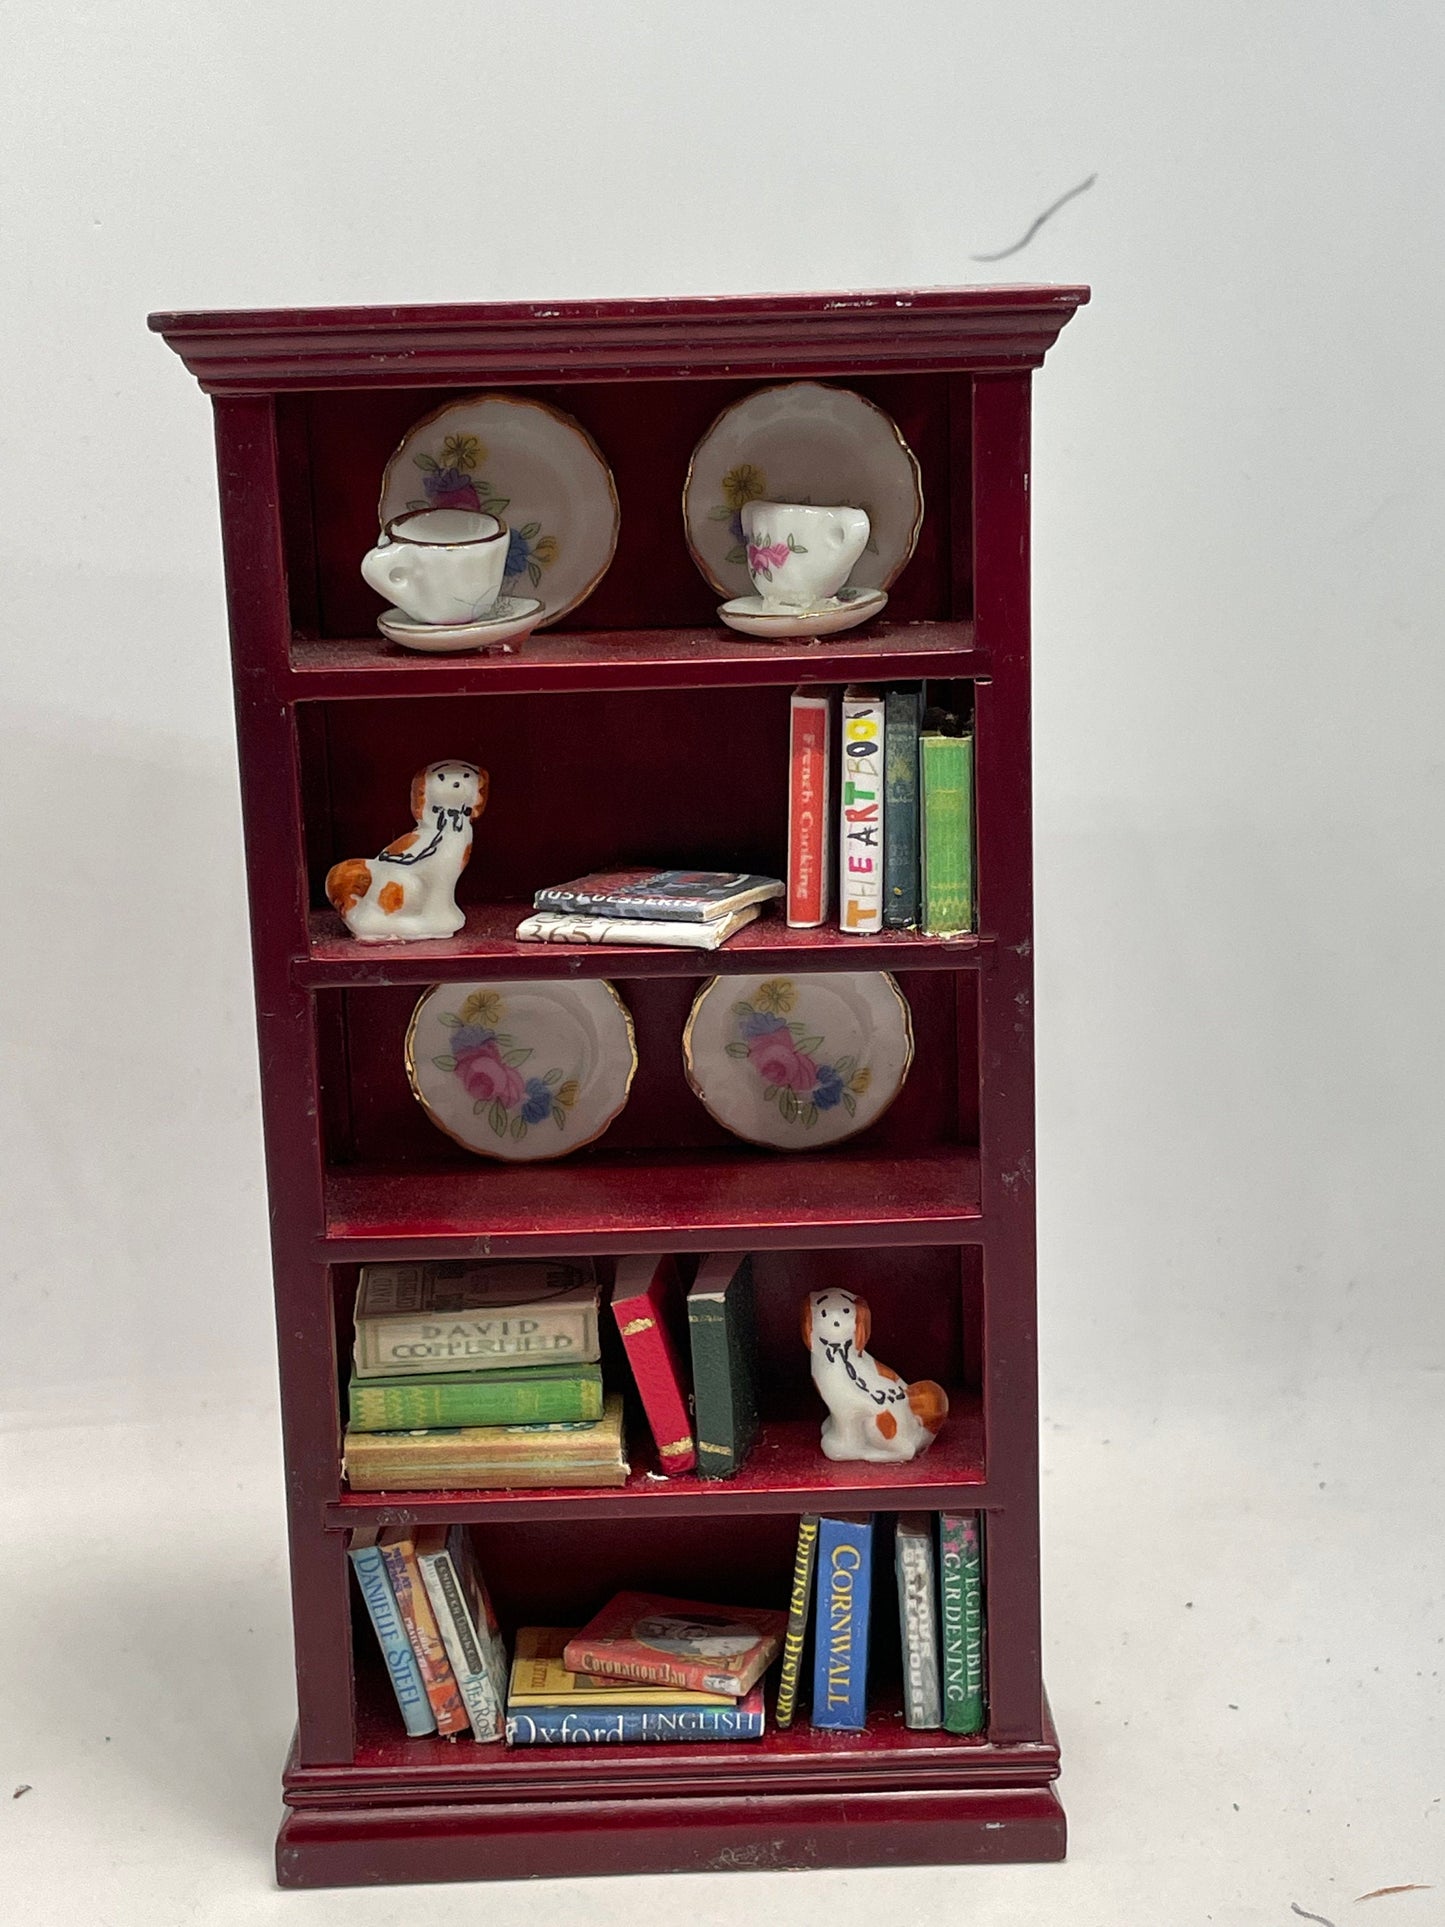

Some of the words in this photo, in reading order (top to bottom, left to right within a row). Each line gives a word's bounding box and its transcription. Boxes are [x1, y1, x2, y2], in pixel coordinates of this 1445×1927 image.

[845, 708, 879, 777] BOOK
[844, 781, 879, 846] ART
[846, 856, 878, 928] THE
[421, 1319, 540, 1340] DAVID
[790, 1523, 817, 1617] BRITISH
[356, 1554, 400, 1643] DANIELLE
[386, 1648, 421, 1714] STEEL
[827, 1544, 862, 1713] CORNWALL
[943, 1552, 965, 1702] GARDENING
[964, 1558, 982, 1699] VEGETABLE
[465, 1681, 487, 1708] TEA
[581, 1651, 657, 1680] Coronation
[775, 1633, 804, 1723] HISTORY
[472, 1705, 494, 1740] ROSE
[642, 1712, 754, 1732] ENGLISH
